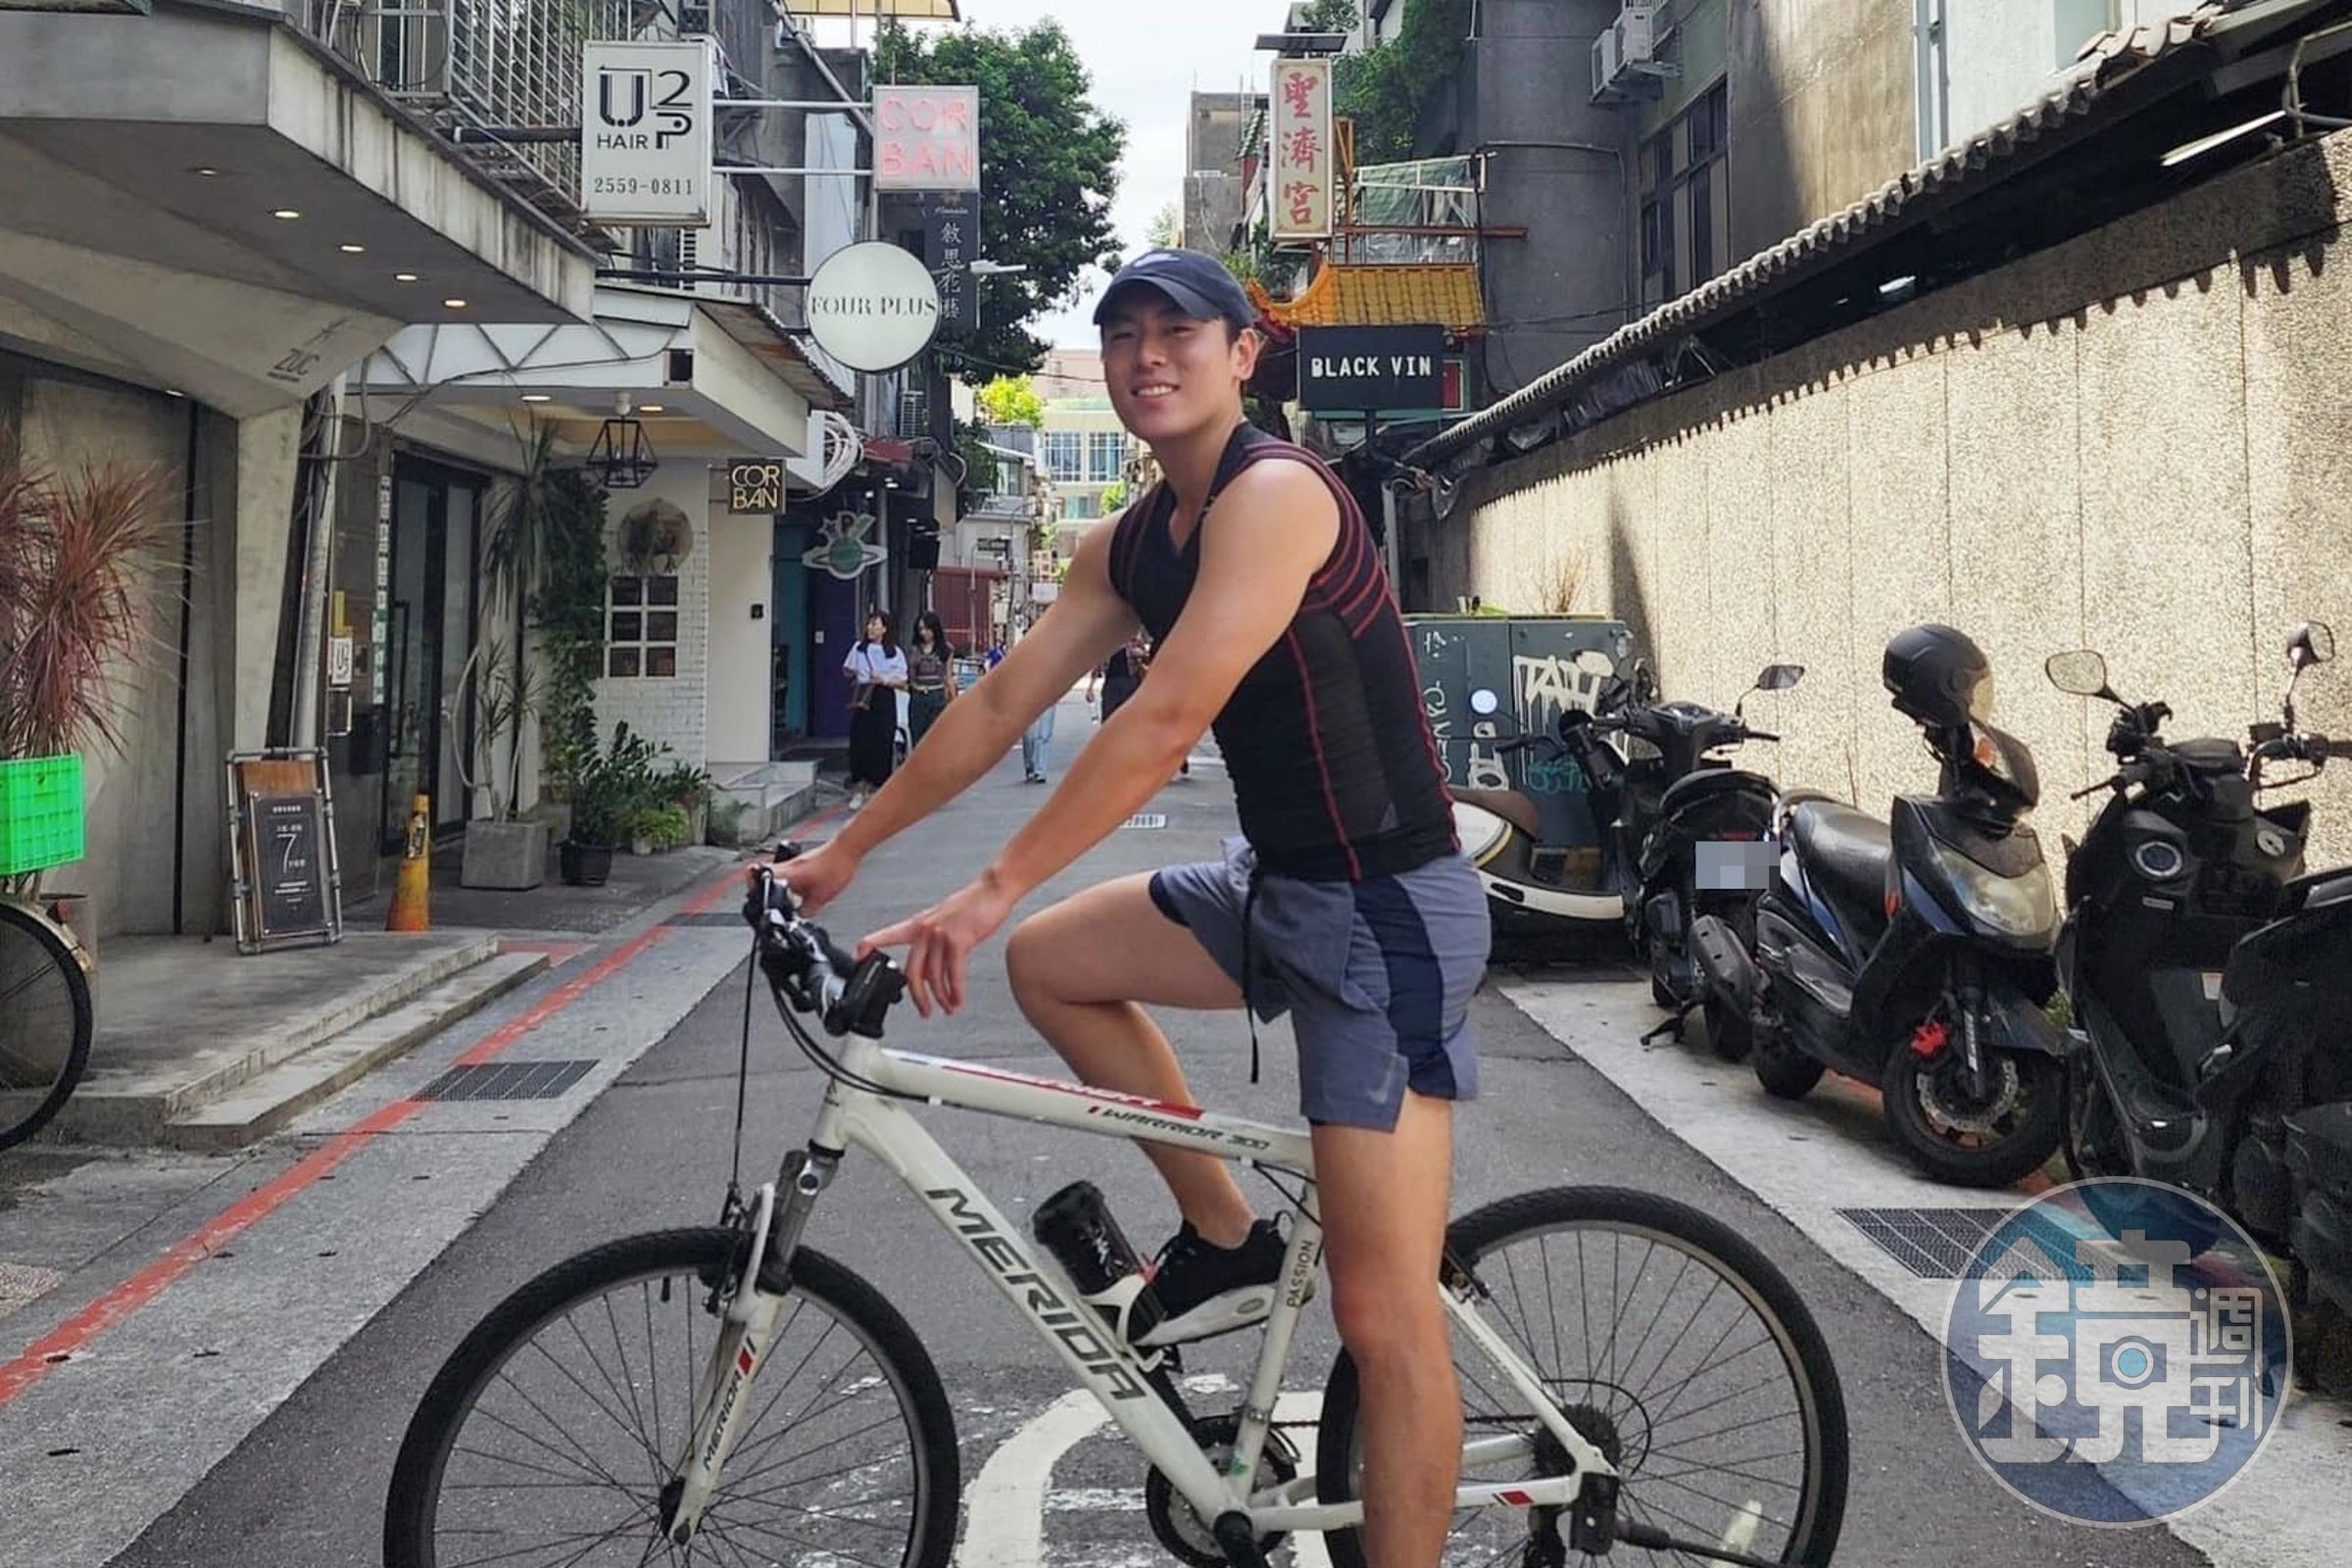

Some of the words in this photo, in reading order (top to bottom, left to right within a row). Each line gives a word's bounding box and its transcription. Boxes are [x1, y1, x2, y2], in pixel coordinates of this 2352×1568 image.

[880, 97, 972, 132] COR
[596, 133, 649, 150] HAIR
[881, 139, 973, 177] BAN
[1282, 72, 1323, 225] 聖濟宮
[593, 177, 692, 195] 2559-0811
[811, 297, 871, 316] FOUR
[881, 297, 937, 316] PLUS
[1310, 356, 1380, 377] BLACK
[1391, 355, 1432, 376] VIN
[731, 465, 781, 487] COR
[732, 487, 778, 510] BAN
[1102, 1107, 1224, 1141] WARRIOR
[1286, 1240, 1313, 1308] PASSION
[925, 1188, 1147, 1400] MERIDA
[704, 1369, 742, 1471] MERIDA
